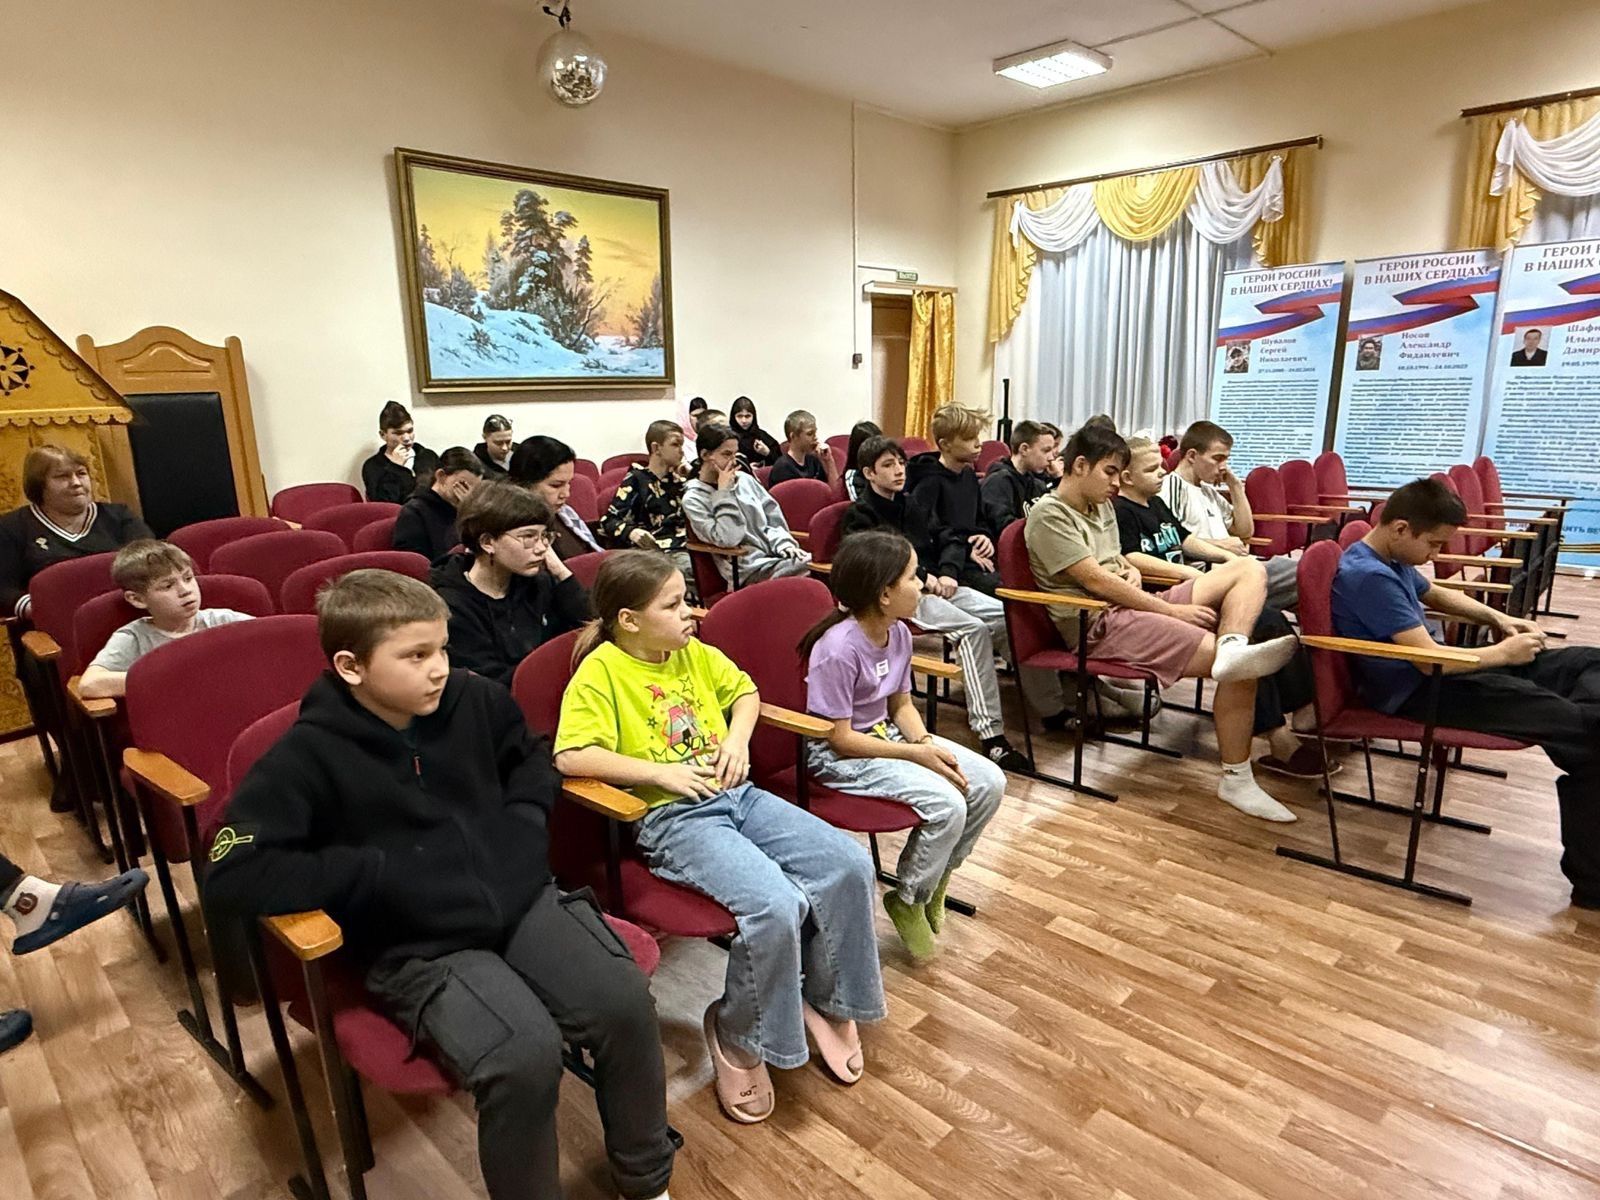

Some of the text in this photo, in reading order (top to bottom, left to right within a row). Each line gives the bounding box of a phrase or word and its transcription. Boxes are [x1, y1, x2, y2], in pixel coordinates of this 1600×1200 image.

[1543, 245, 1592, 258] ГЕРОИ
[1379, 255, 1475, 272] ГЕРОИ РОССИИ
[1524, 262, 1534, 272] В
[1537, 257, 1595, 271] НАШИХ
[1243, 269, 1321, 284] ГЕРОИ РОССИИ
[1364, 266, 1489, 285] В НАШИХ СЕРДЦАХ!
[1231, 279, 1333, 296] В НАШИХ СЕРДЦАХ!
